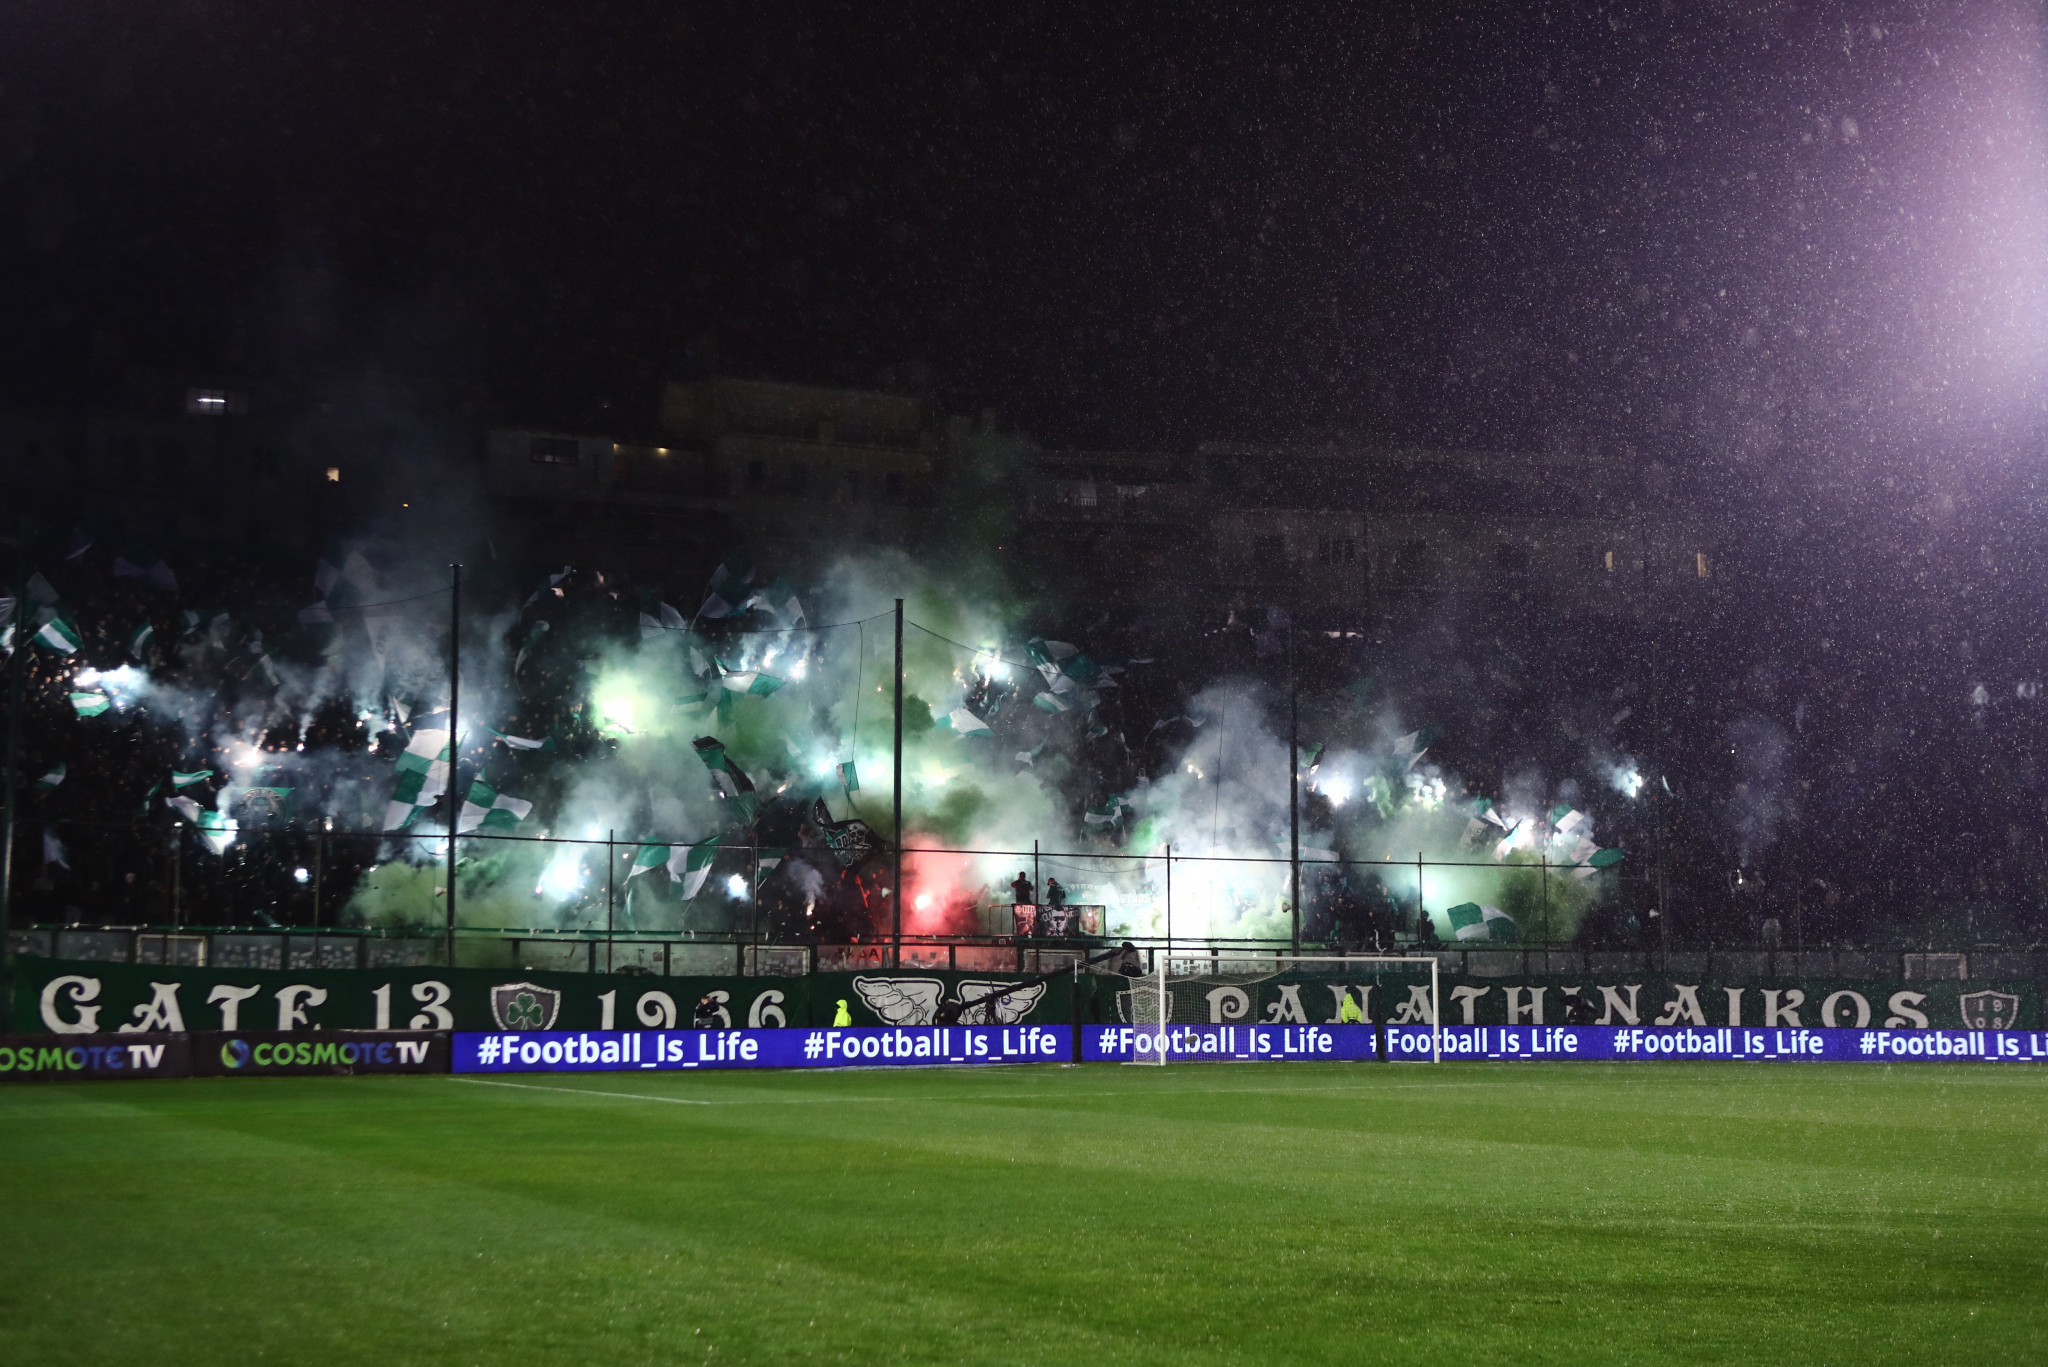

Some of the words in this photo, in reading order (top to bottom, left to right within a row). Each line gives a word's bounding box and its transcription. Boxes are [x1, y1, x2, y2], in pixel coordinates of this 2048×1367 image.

[41, 976, 327, 1033] GATE
[373, 980, 454, 1030] 13
[127, 1044, 166, 1069] TV
[254, 1042, 393, 1066] COSMOTE
[395, 1041, 430, 1064] TV
[478, 1032, 759, 1068] #Football_Is_Life
[804, 1027, 1057, 1062] #Football_Is_Life
[1099, 1027, 1333, 1058] #Football_Is_Life
[1614, 1029, 1824, 1058] #Football_Is_Life
